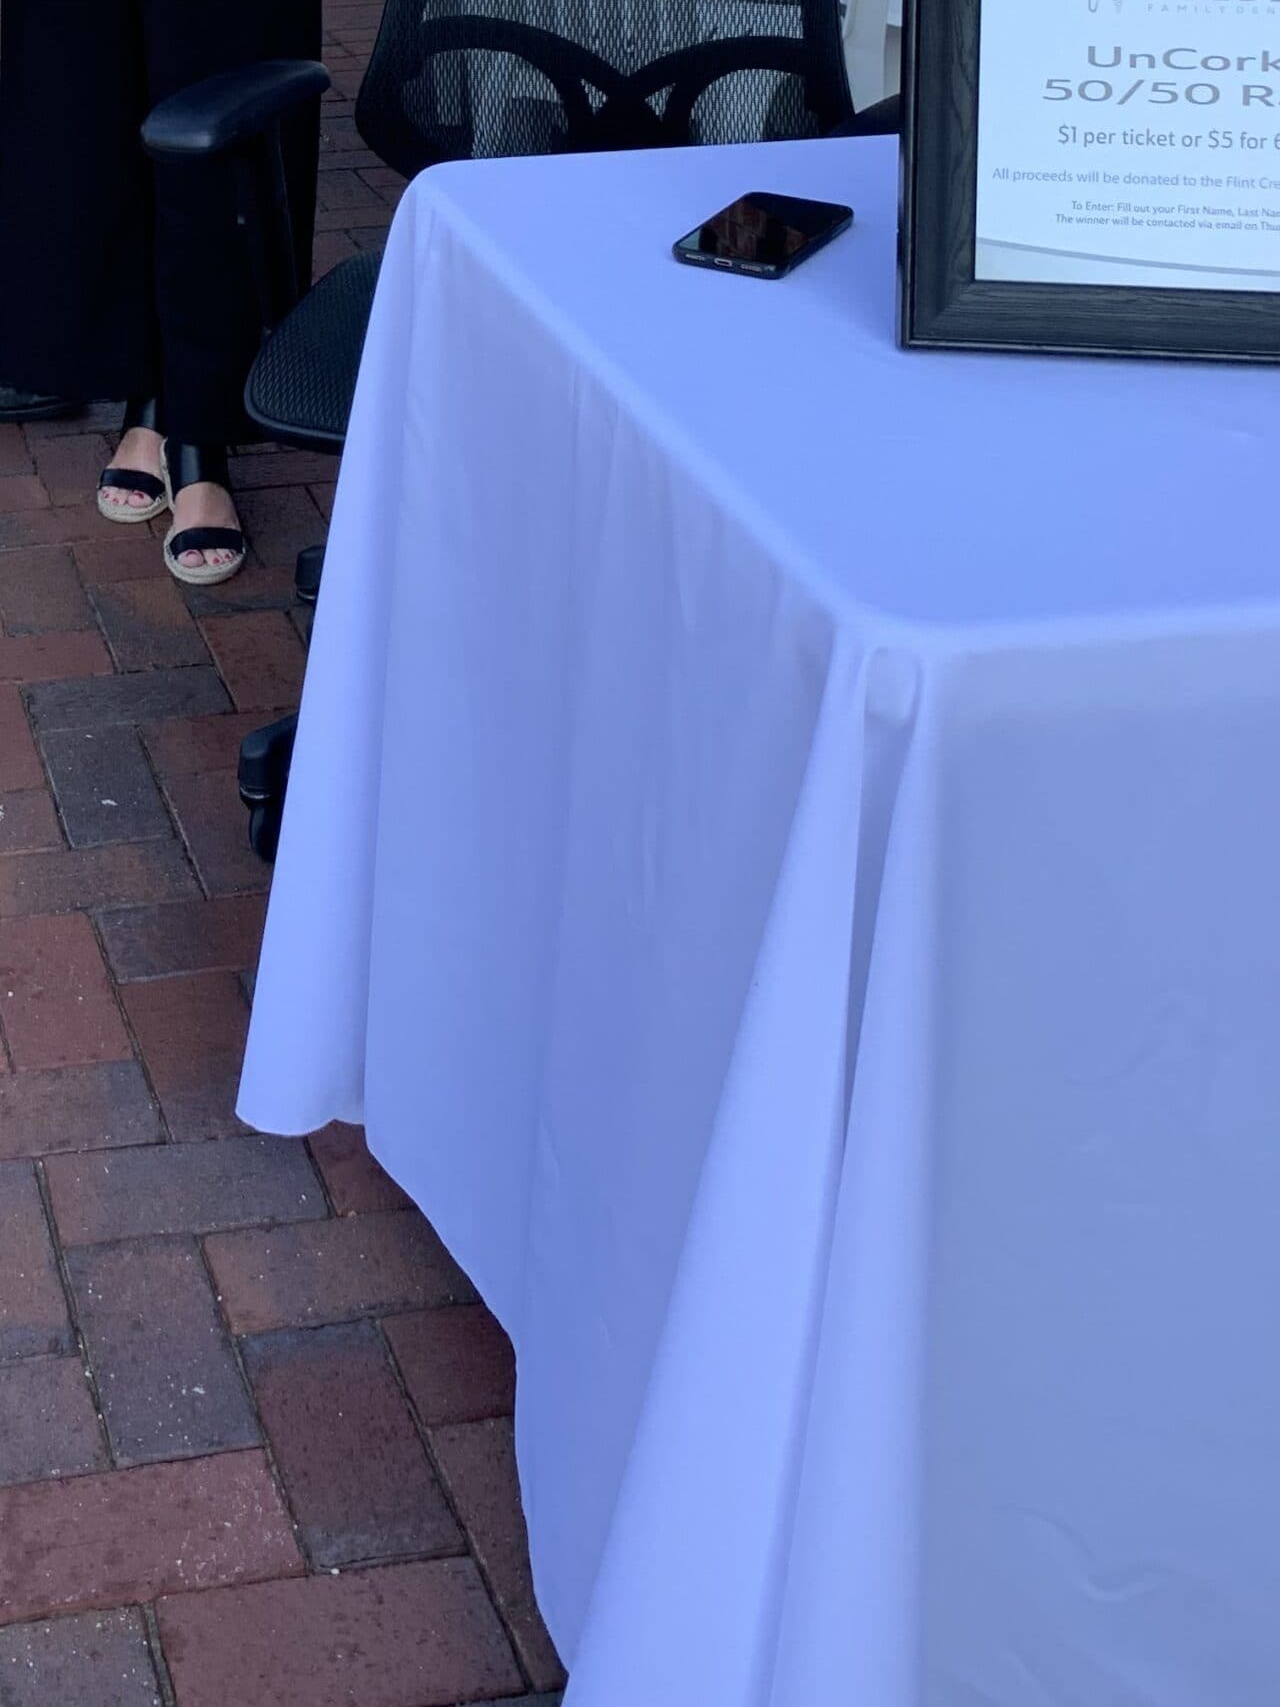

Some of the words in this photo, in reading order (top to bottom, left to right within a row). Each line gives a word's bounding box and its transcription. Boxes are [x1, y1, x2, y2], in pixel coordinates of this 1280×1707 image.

[1041, 78, 1221, 106] 50/50
[1241, 84, 1280, 107] R
[1057, 123, 1077, 145] $1
[1083, 131, 1116, 148] per
[1122, 128, 1176, 147] ticket
[1181, 134, 1203, 148] or
[1207, 128, 1233, 150] $5
[1240, 131, 1268, 150] for
[992, 167, 1009, 180] All
[1012, 169, 1073, 183] proceeds
[1076, 170, 1099, 183] will
[1103, 171, 1120, 184] be
[1122, 173, 1179, 186] donated
[1183, 175, 1197, 187] to
[1200, 175, 1223, 188] the
[1226, 176, 1256, 189] Flint
[1071, 200, 1083, 211] To
[1117, 202, 1131, 213] Fill
[1133, 205, 1150, 214] out
[1152, 205, 1176, 215] your
[1177, 204, 1200, 215] First
[1238, 207, 1258, 217] Last
[1056, 213, 1074, 224] The
[1076, 216, 1109, 225] winner
[1111, 216, 1129, 226] will
[1131, 216, 1144, 227] be
[1146, 219, 1196, 229] contacted
[1198, 220, 1213, 230] via
[1215, 220, 1242, 230] email
[1244, 223, 1258, 231] on
